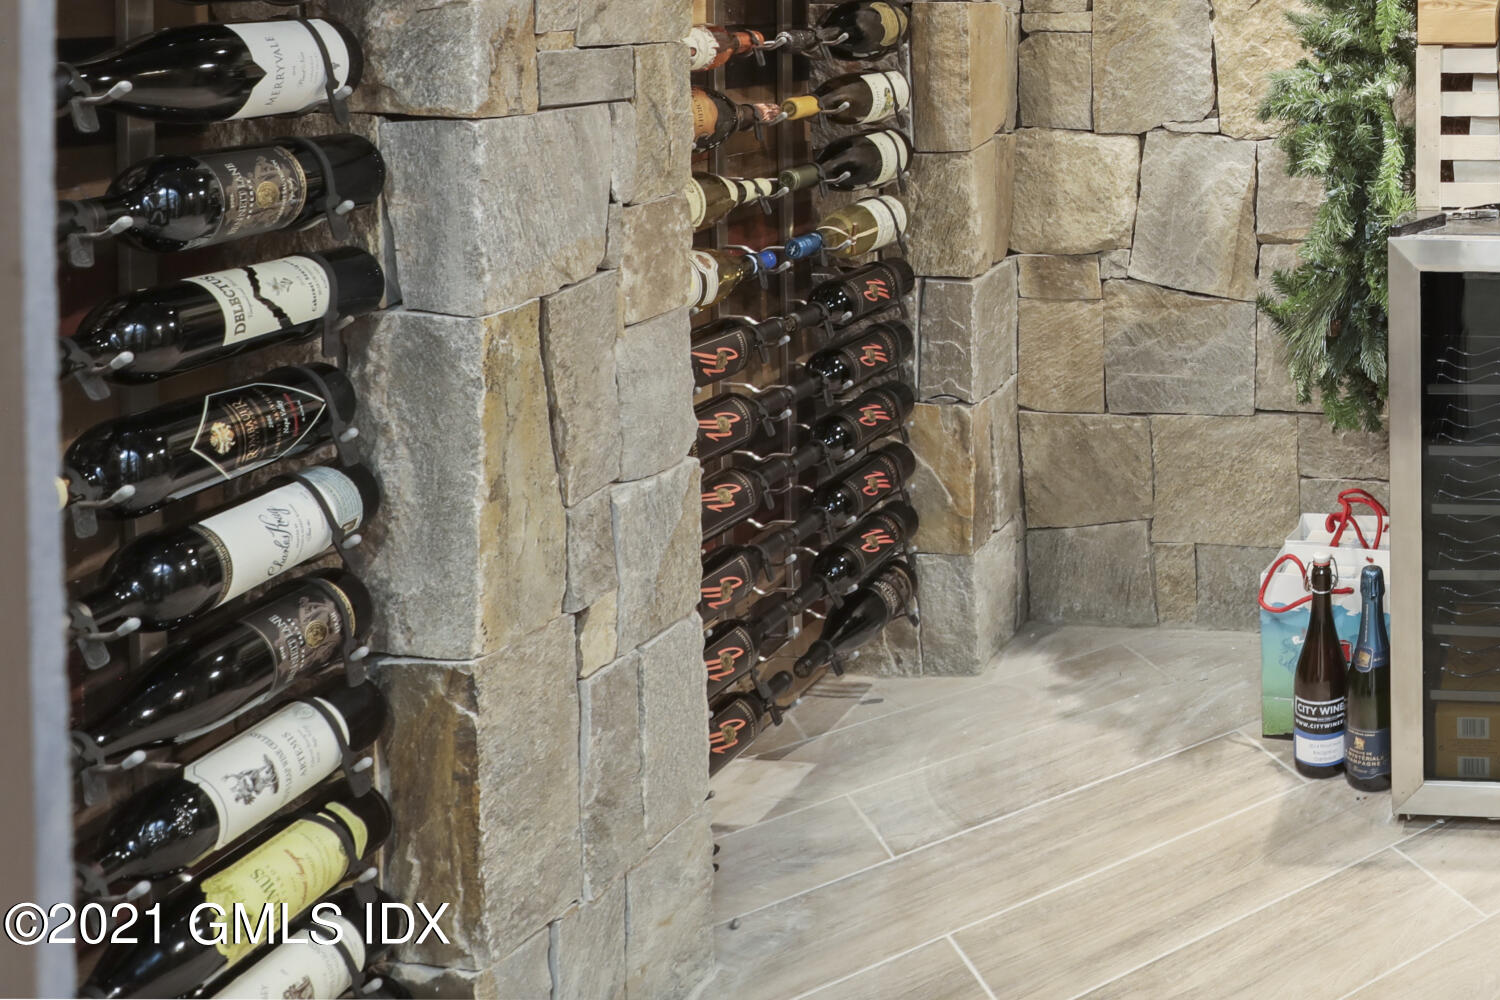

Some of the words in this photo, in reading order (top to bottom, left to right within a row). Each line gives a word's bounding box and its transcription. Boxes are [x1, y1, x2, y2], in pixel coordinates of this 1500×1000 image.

[264, 36, 285, 106] MERRYVALE
[232, 400, 258, 459] ROMBAUER
[268, 615, 293, 639] LANE
[1297, 704, 1318, 715] CITY
[282, 731, 307, 777] ARTEMIS
